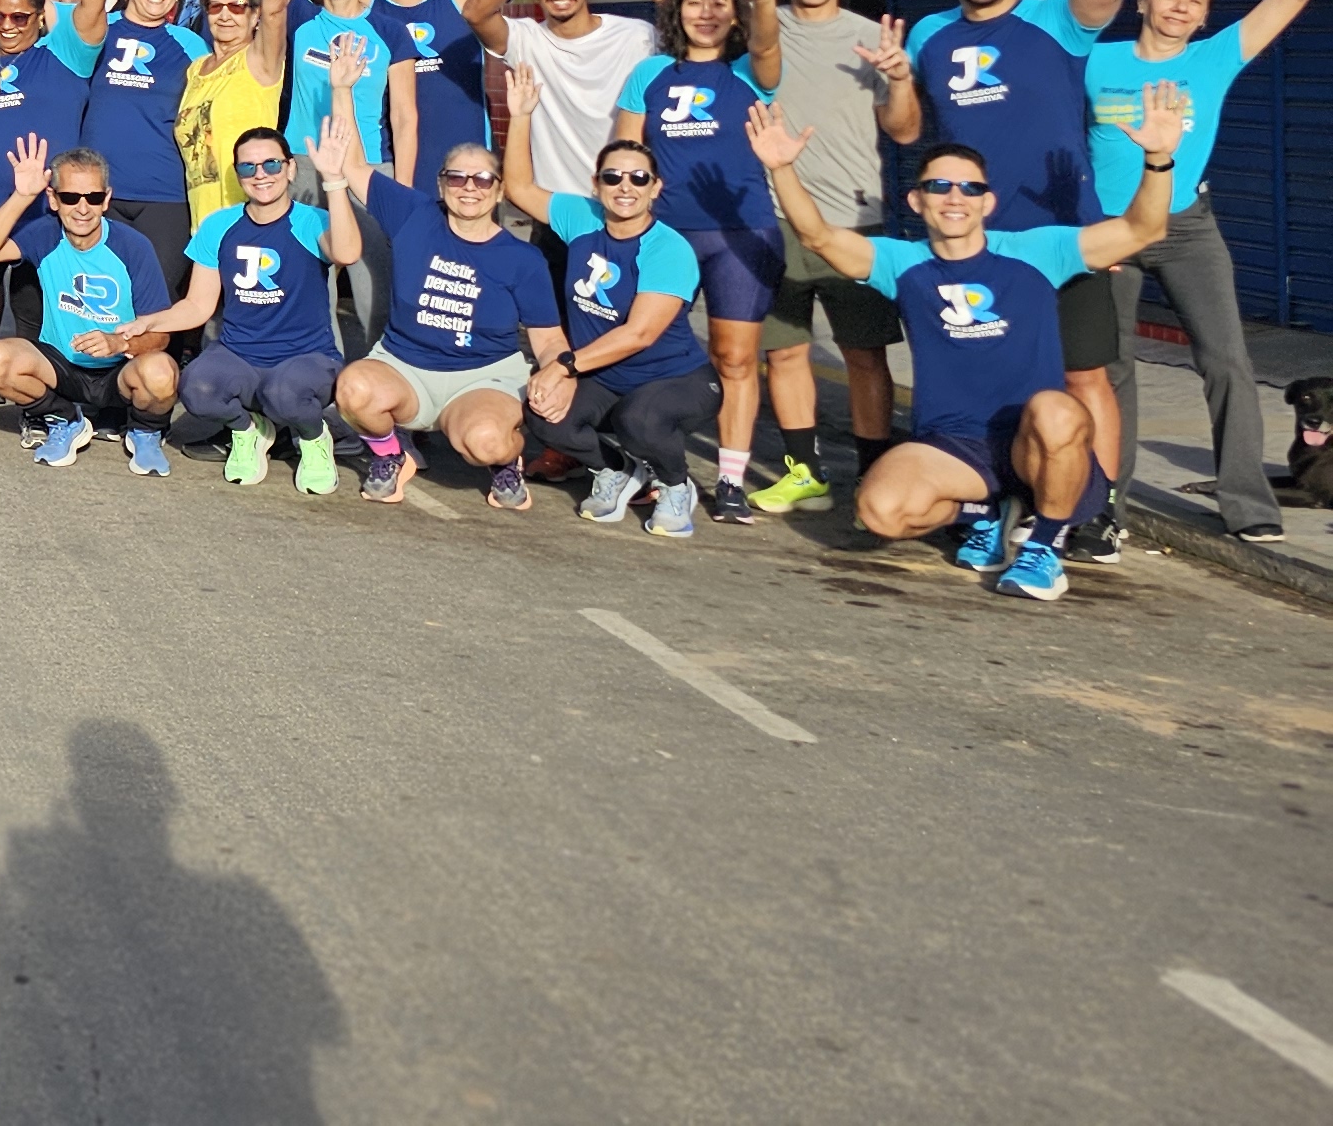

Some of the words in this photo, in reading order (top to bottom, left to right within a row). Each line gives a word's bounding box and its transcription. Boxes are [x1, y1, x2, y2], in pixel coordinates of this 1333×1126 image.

[105, 70, 155, 85] ASSESSORIA
[660, 85, 715, 122] JR
[660, 120, 720, 132] ASSESSORIA
[666, 128, 715, 138] ESPORTIVA
[233, 245, 281, 291] JR
[235, 288, 284, 299] ASSESSORIA
[423, 275, 482, 300] persistir
[239, 295, 281, 305] ESPORTIVA
[418, 294, 429, 307] e
[429, 294, 474, 317] nunca
[416, 310, 473, 334] desistir!
[454, 332, 473, 348] JR
